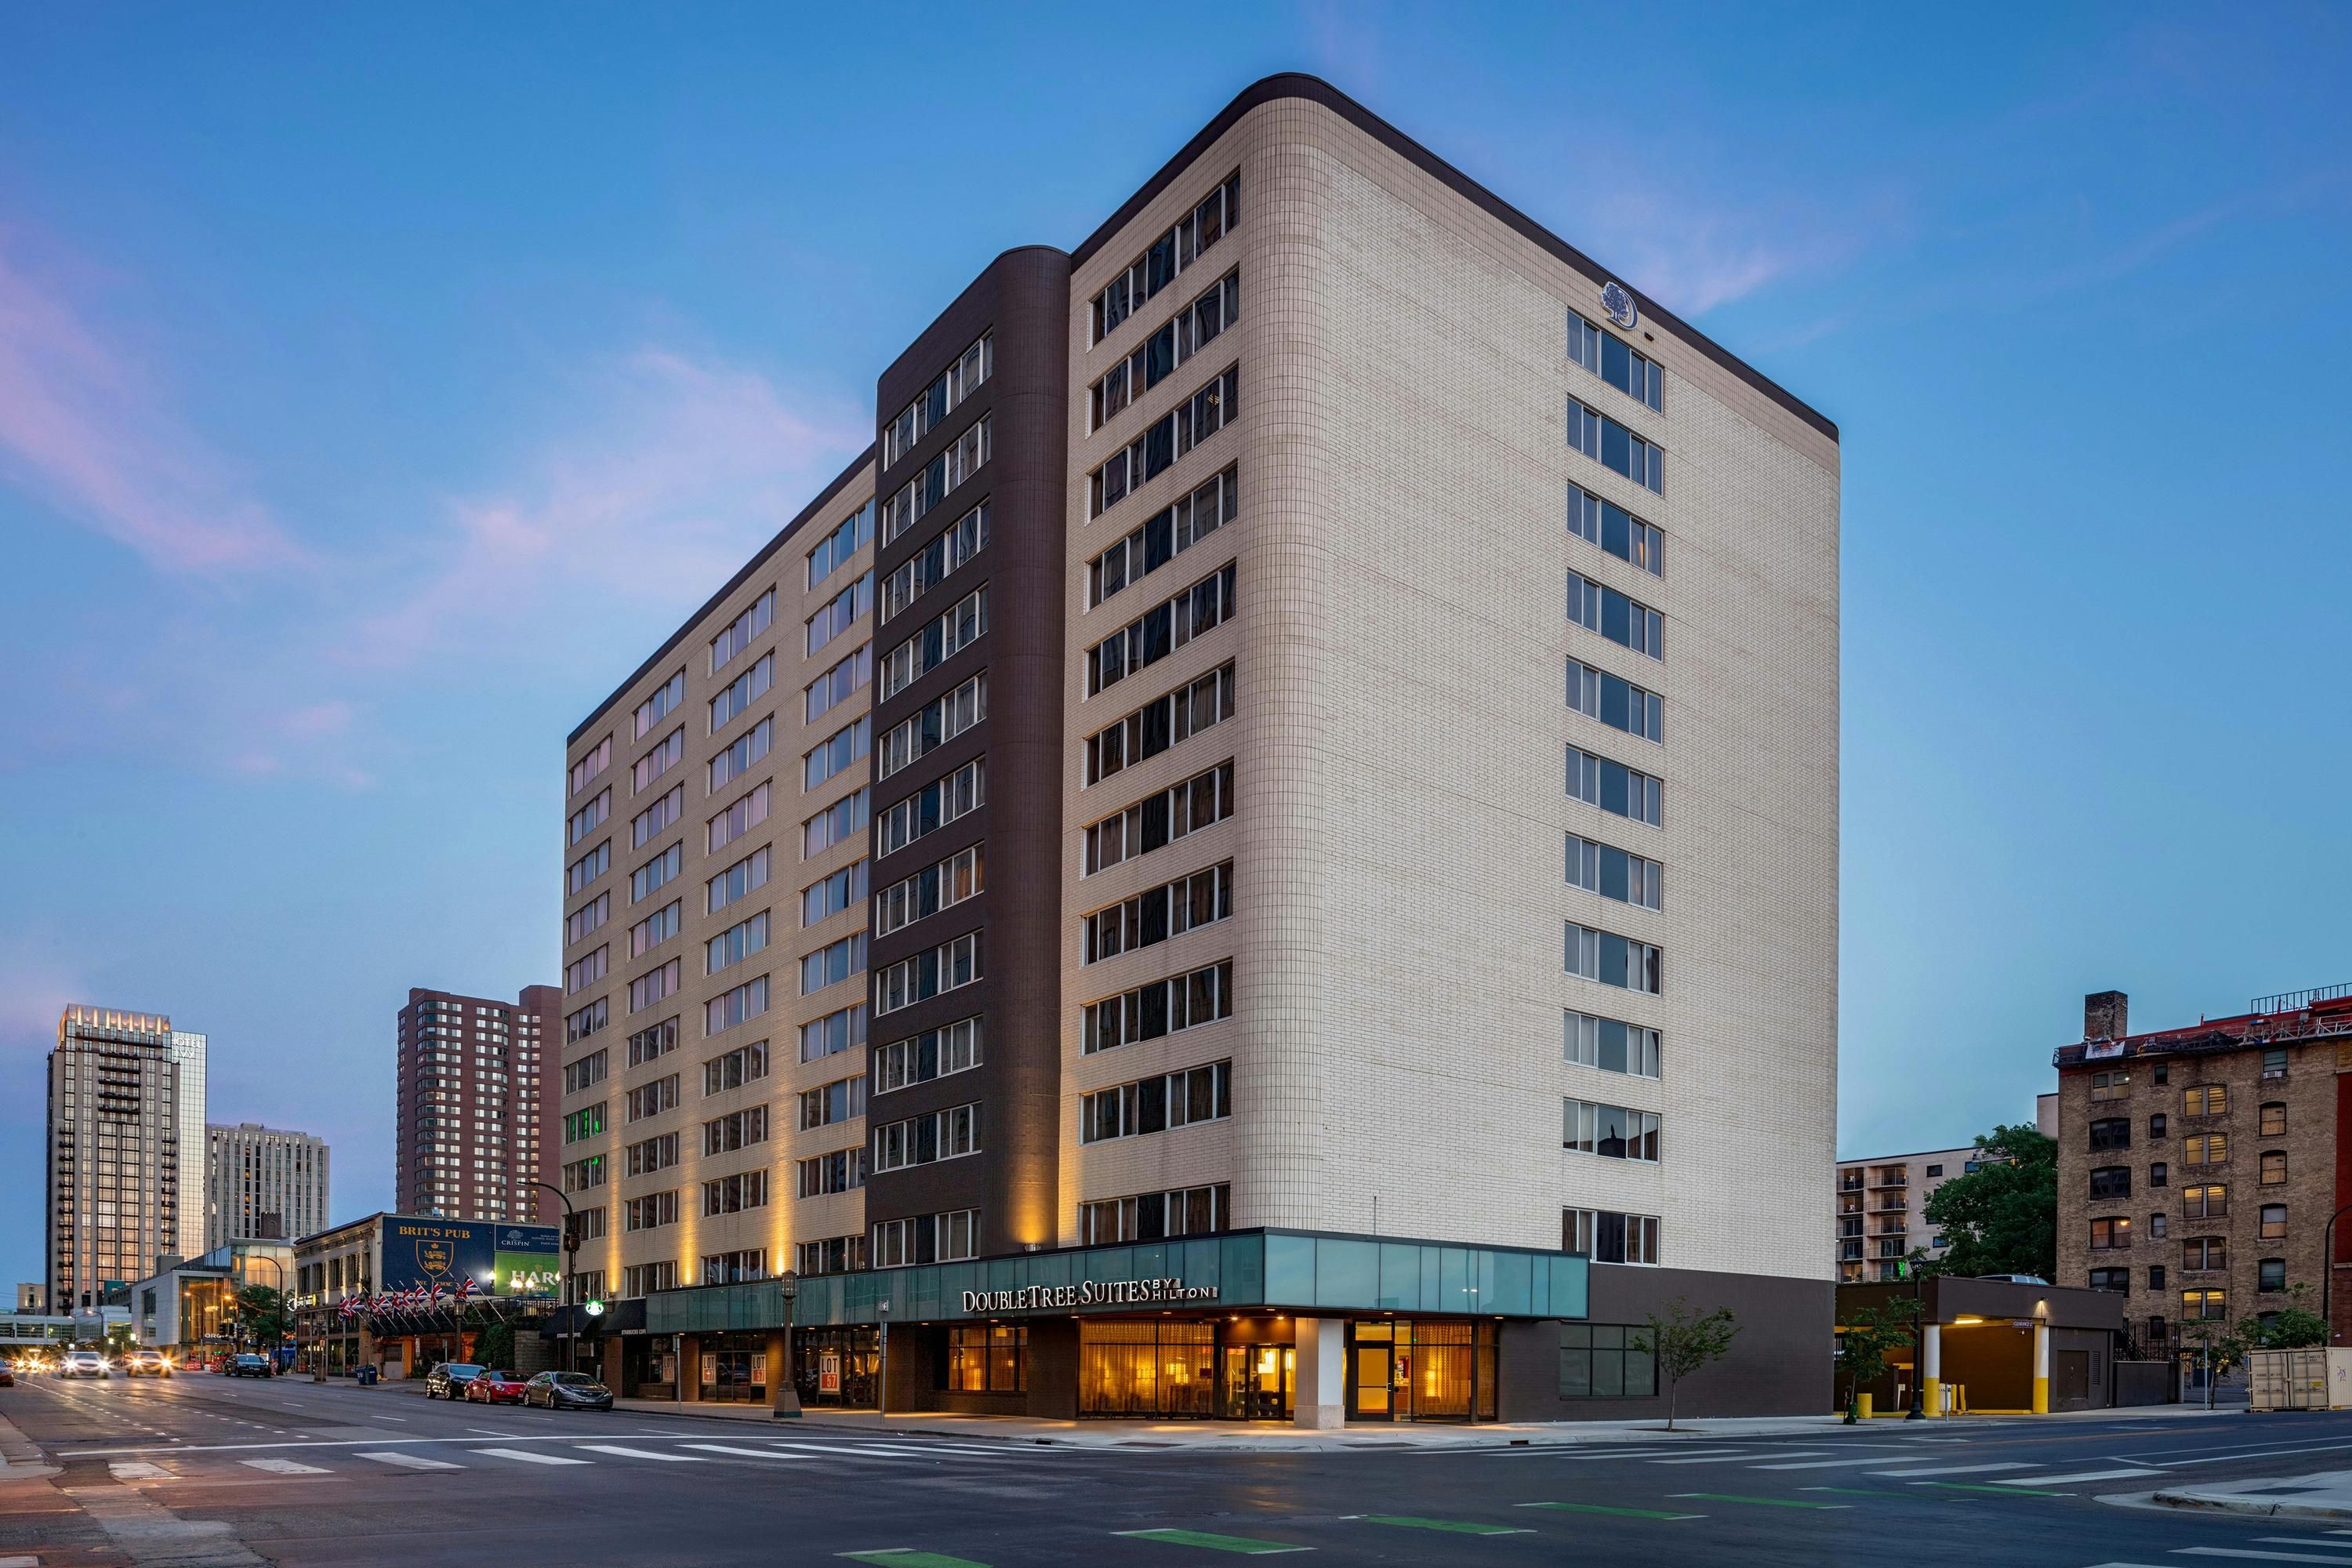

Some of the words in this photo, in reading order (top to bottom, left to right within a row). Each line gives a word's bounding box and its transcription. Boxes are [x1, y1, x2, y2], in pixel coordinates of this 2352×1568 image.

[399, 1226, 440, 1236] BRIT'S
[445, 1229, 470, 1239] PUB
[511, 1270, 556, 1286] HAR
[1152, 1279, 1172, 1290] BY
[1081, 1279, 1150, 1304] SUITES
[1153, 1287, 1209, 1301] HILTON
[703, 1357, 714, 1369] LOT
[753, 1357, 764, 1369] LOT
[822, 1358, 837, 1373] LOT
[826, 1374, 837, 1388] 57
